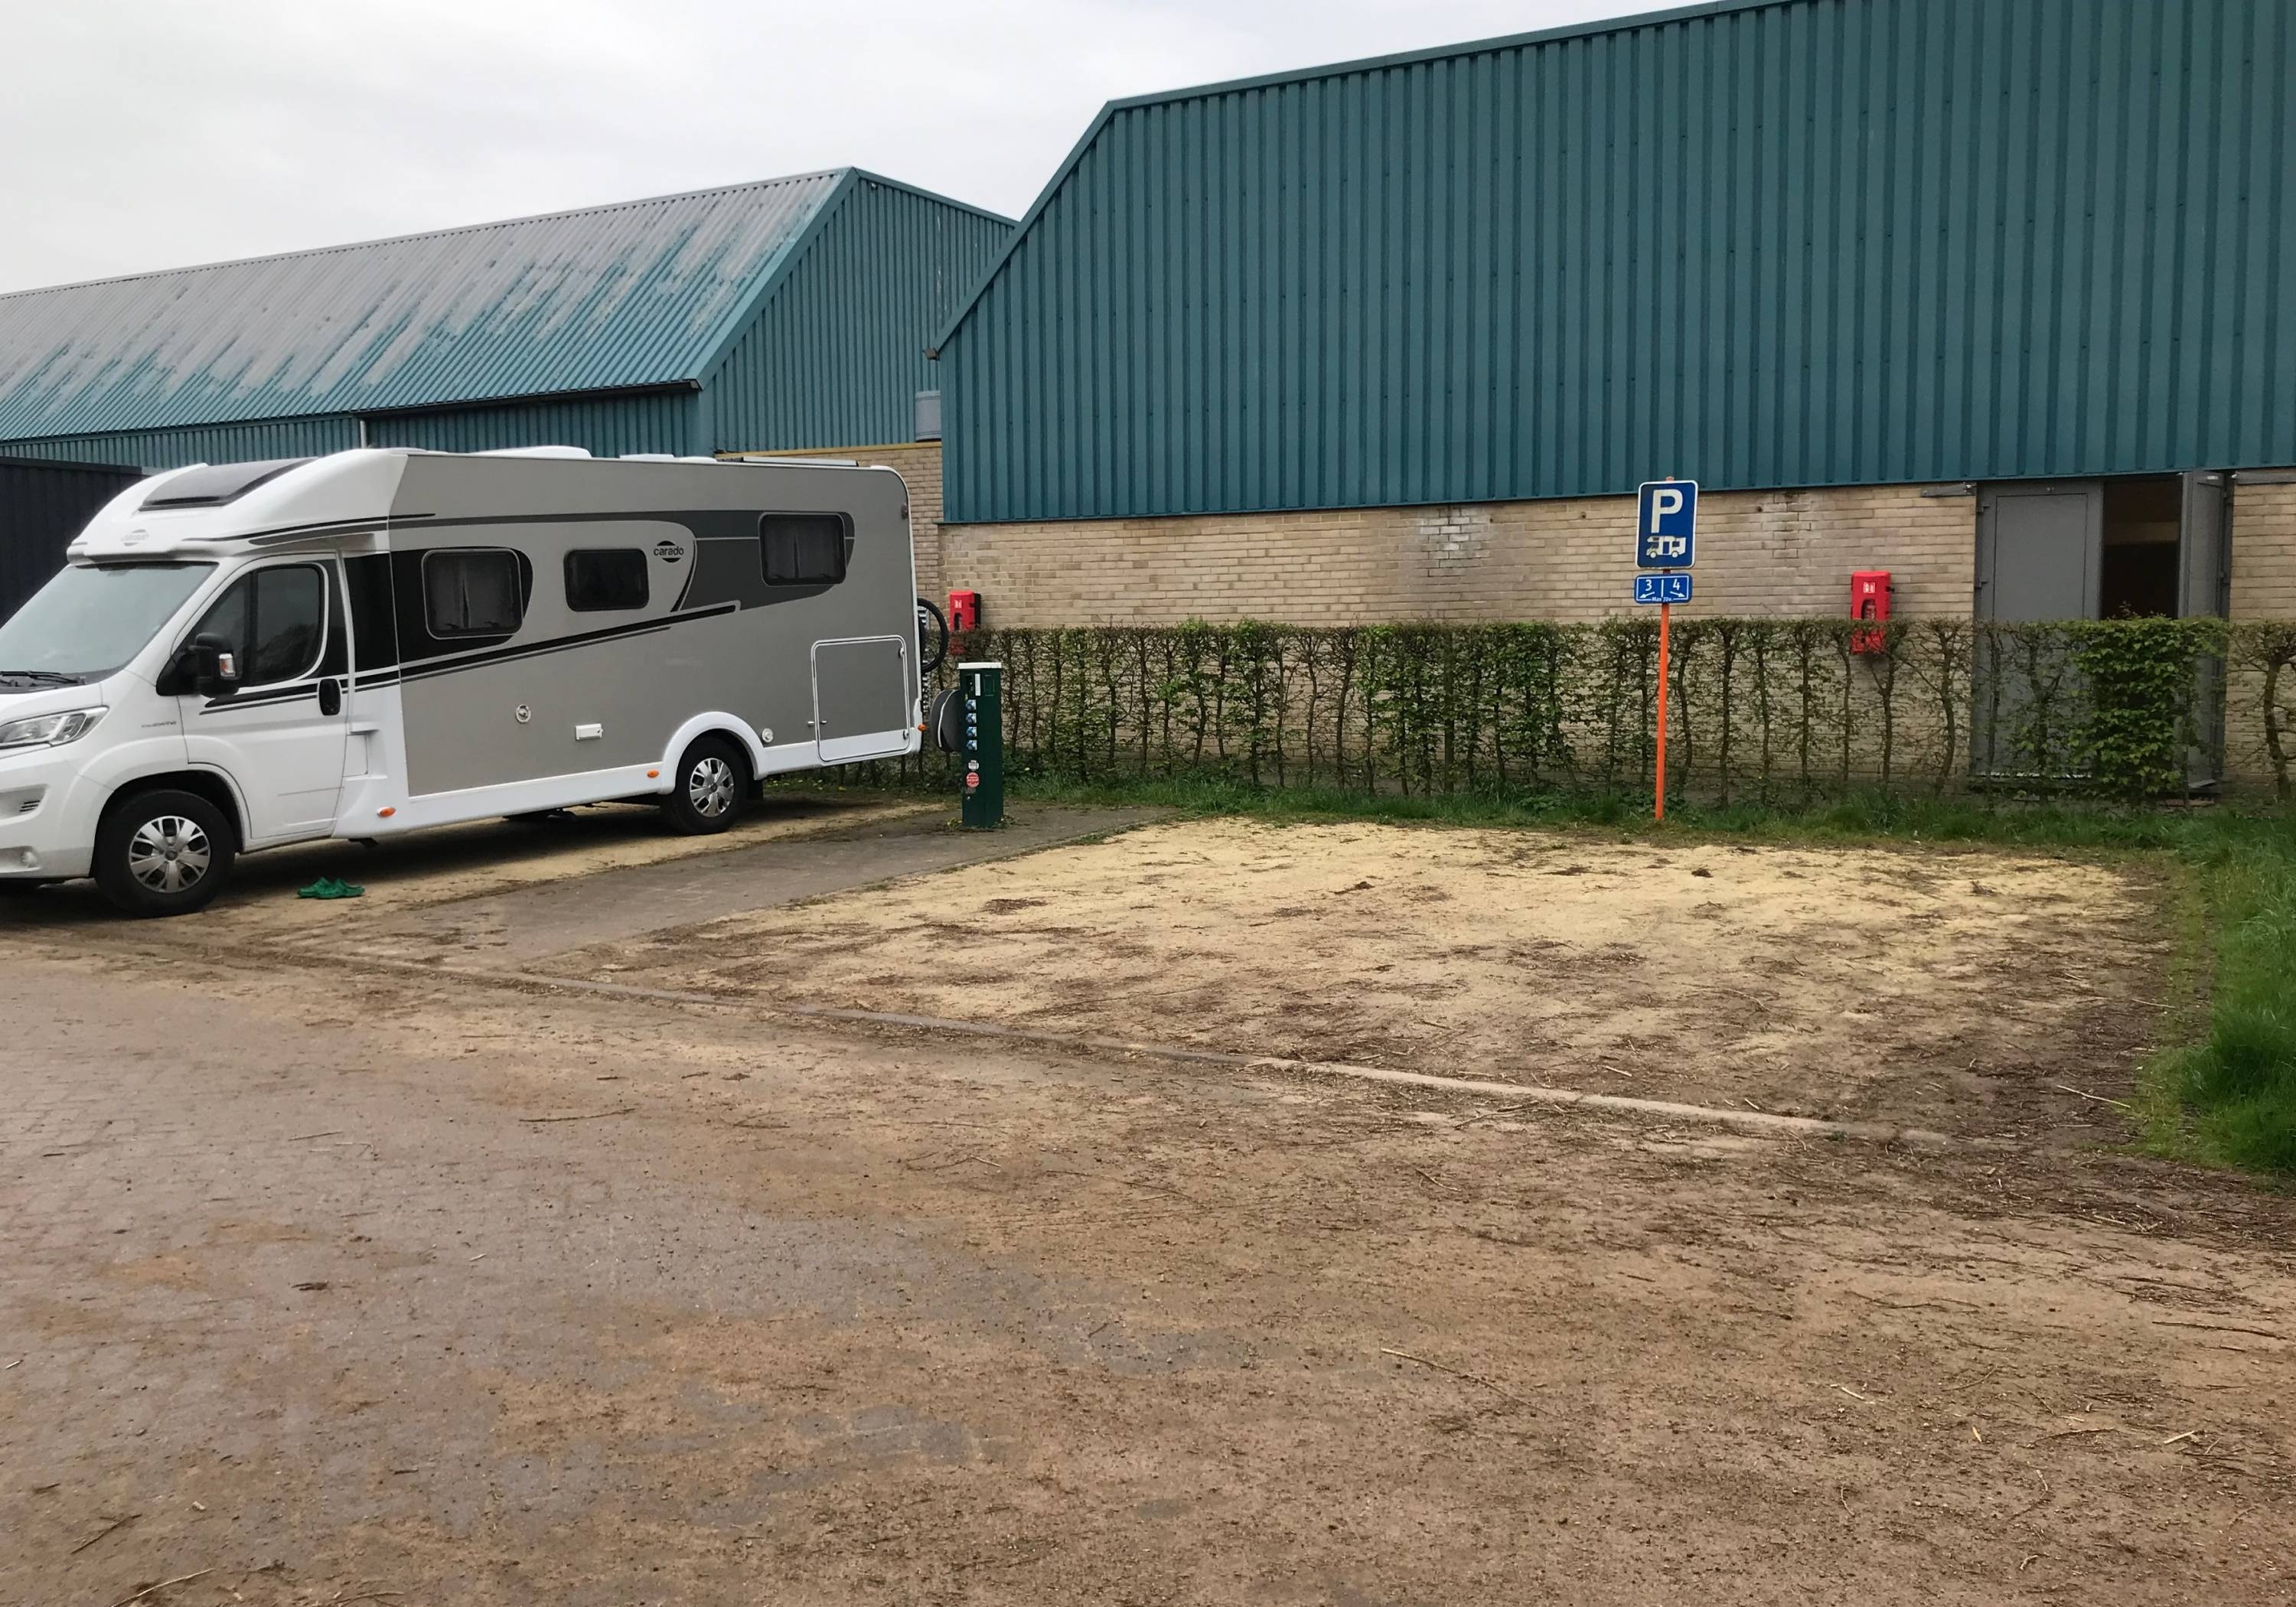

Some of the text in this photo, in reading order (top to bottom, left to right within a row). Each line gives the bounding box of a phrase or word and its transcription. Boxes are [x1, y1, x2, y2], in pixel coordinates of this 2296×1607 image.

[1651, 489, 1683, 533] P
[654, 546, 684, 556] carado
[1645, 579, 1652, 592] 3
[1672, 579, 1681, 591] 4
